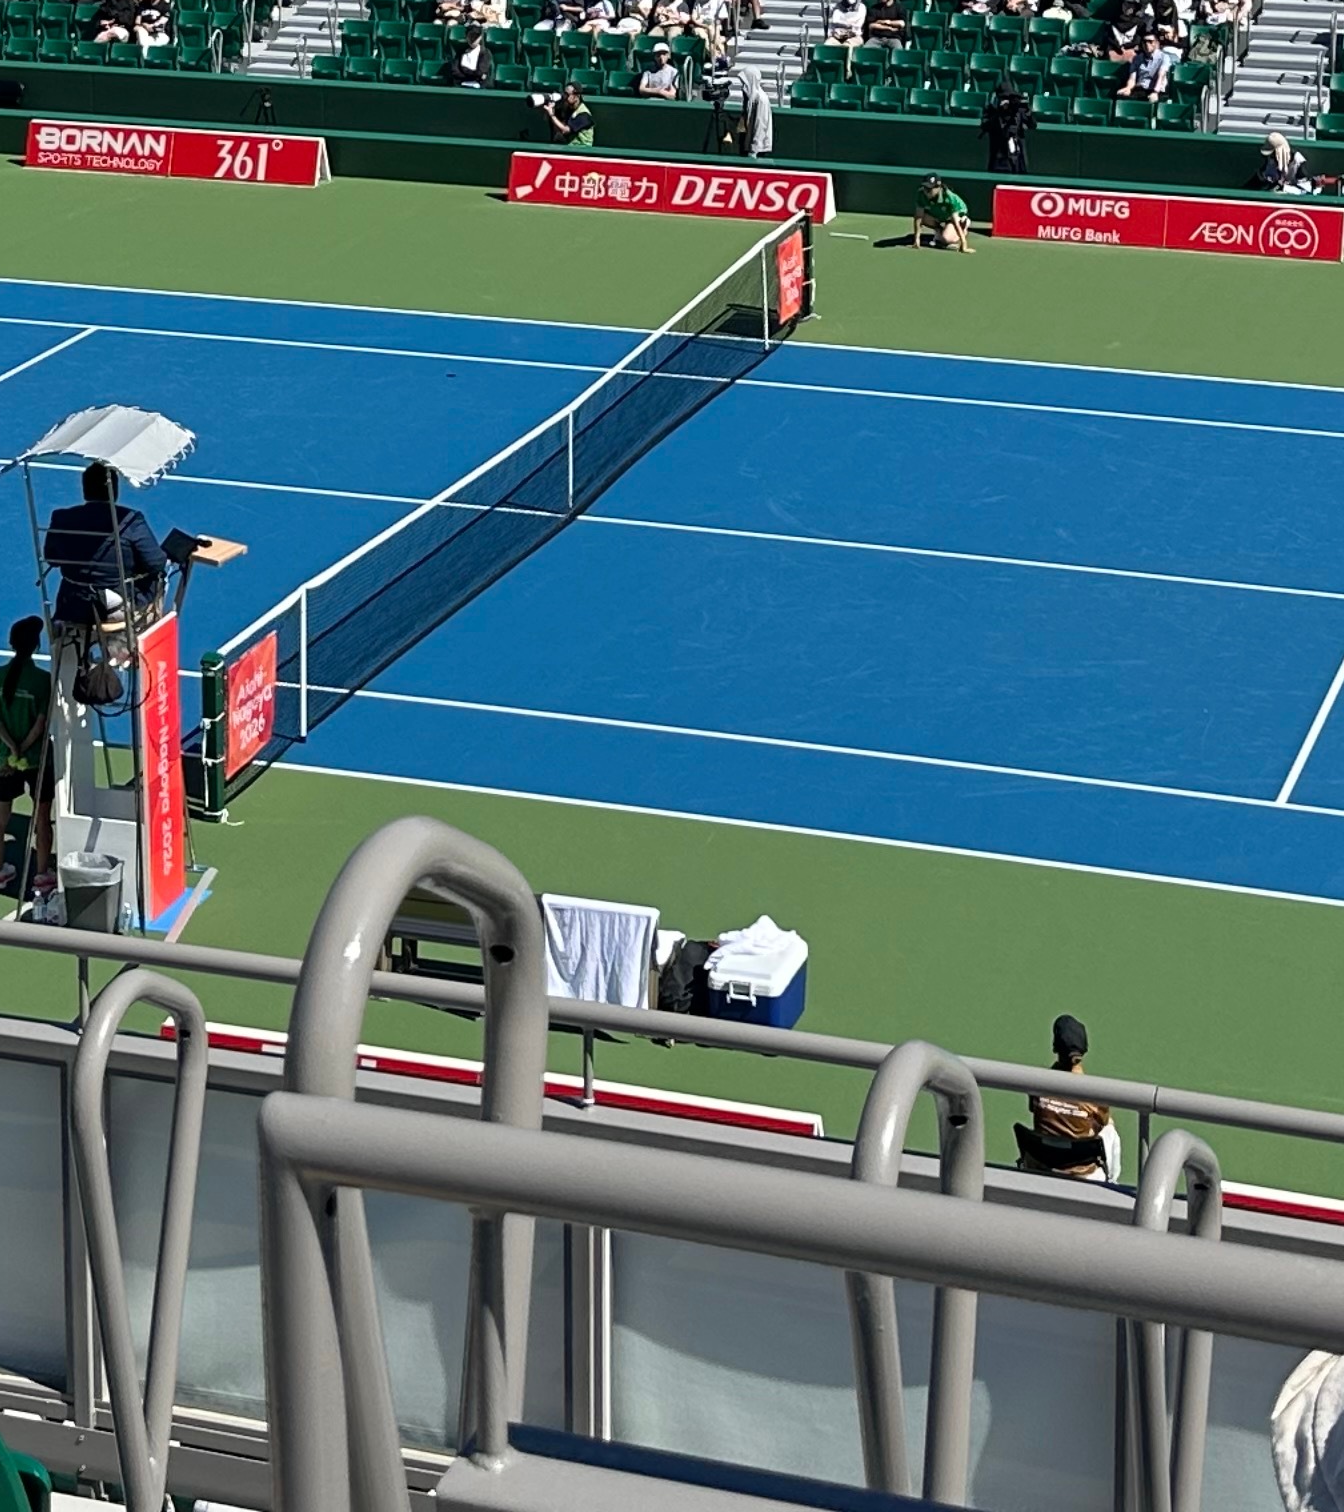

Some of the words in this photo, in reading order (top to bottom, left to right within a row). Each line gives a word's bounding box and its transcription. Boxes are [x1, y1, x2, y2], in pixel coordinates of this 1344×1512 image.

[35, 126, 167, 157] BORNAN
[37, 151, 82, 166] SPORTS
[84, 154, 164, 172] TECHNOLOGY
[554, 171, 659, 204] 中部電力
[670, 175, 821, 214] DENSO
[1066, 200, 1131, 219] MUFG
[1037, 225, 1082, 240] MUFG
[1084, 228, 1121, 244] Bank
[156, 660, 171, 814] Aichi-Nagoya
[161, 818, 174, 876] 2026
